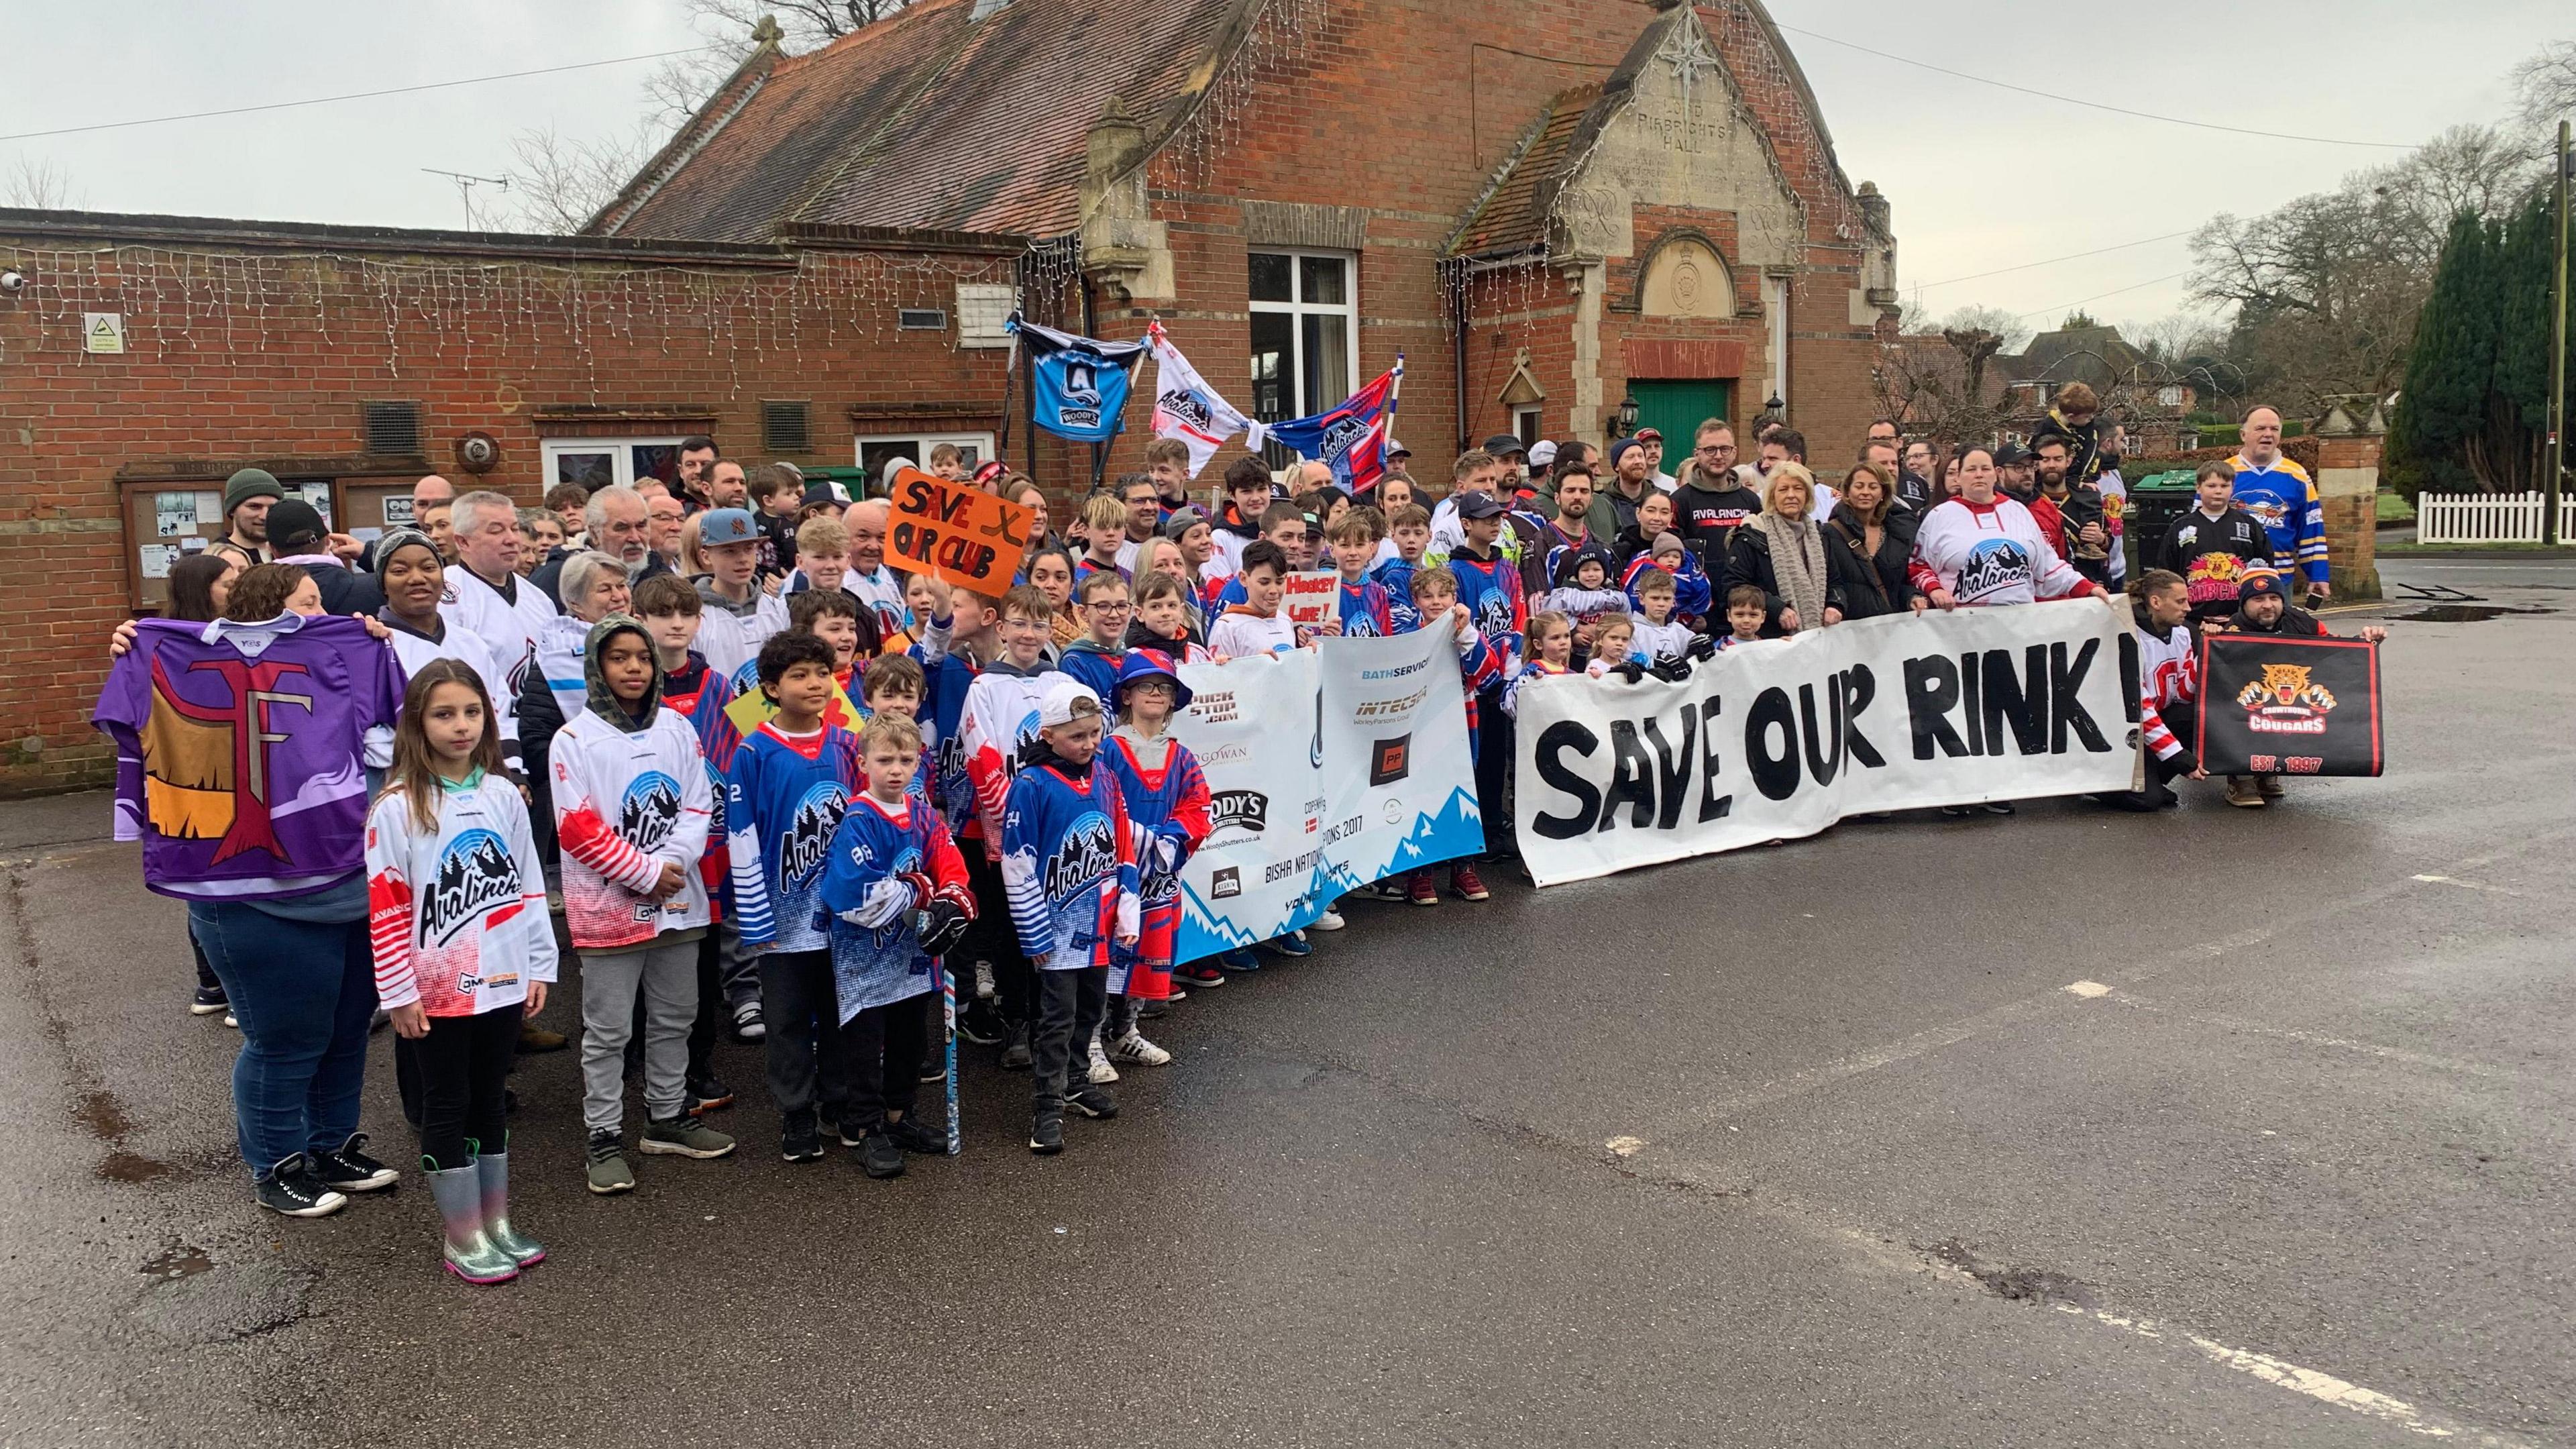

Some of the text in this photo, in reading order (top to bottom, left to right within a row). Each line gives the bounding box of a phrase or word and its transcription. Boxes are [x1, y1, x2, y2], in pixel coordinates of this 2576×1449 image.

[1663, 98, 1704, 118] LOD
[1664, 136, 1703, 154] HALL
[1063, 409, 1098, 423] WOODY'S
[1157, 389, 1208, 434] Avalanche
[898, 480, 975, 530] SAVE
[894, 522, 996, 580] OUR CLUB
[1953, 566, 2033, 600] Avalanche
[1189, 702, 1236, 717] STOP
[1205, 712, 1238, 724] .COM
[2262, 706, 2312, 716] CROWTHORNE
[2249, 715, 2324, 732] COUGARS
[1532, 633, 2143, 840] SAVE OUR RINK!
[1386, 753, 1401, 765] PP
[2251, 755, 2323, 773] EST. 1997
[1212, 793, 1261, 819] ODY'S
[1266, 859, 1292, 883] BISHA
[1343, 815, 1363, 838] 2017
